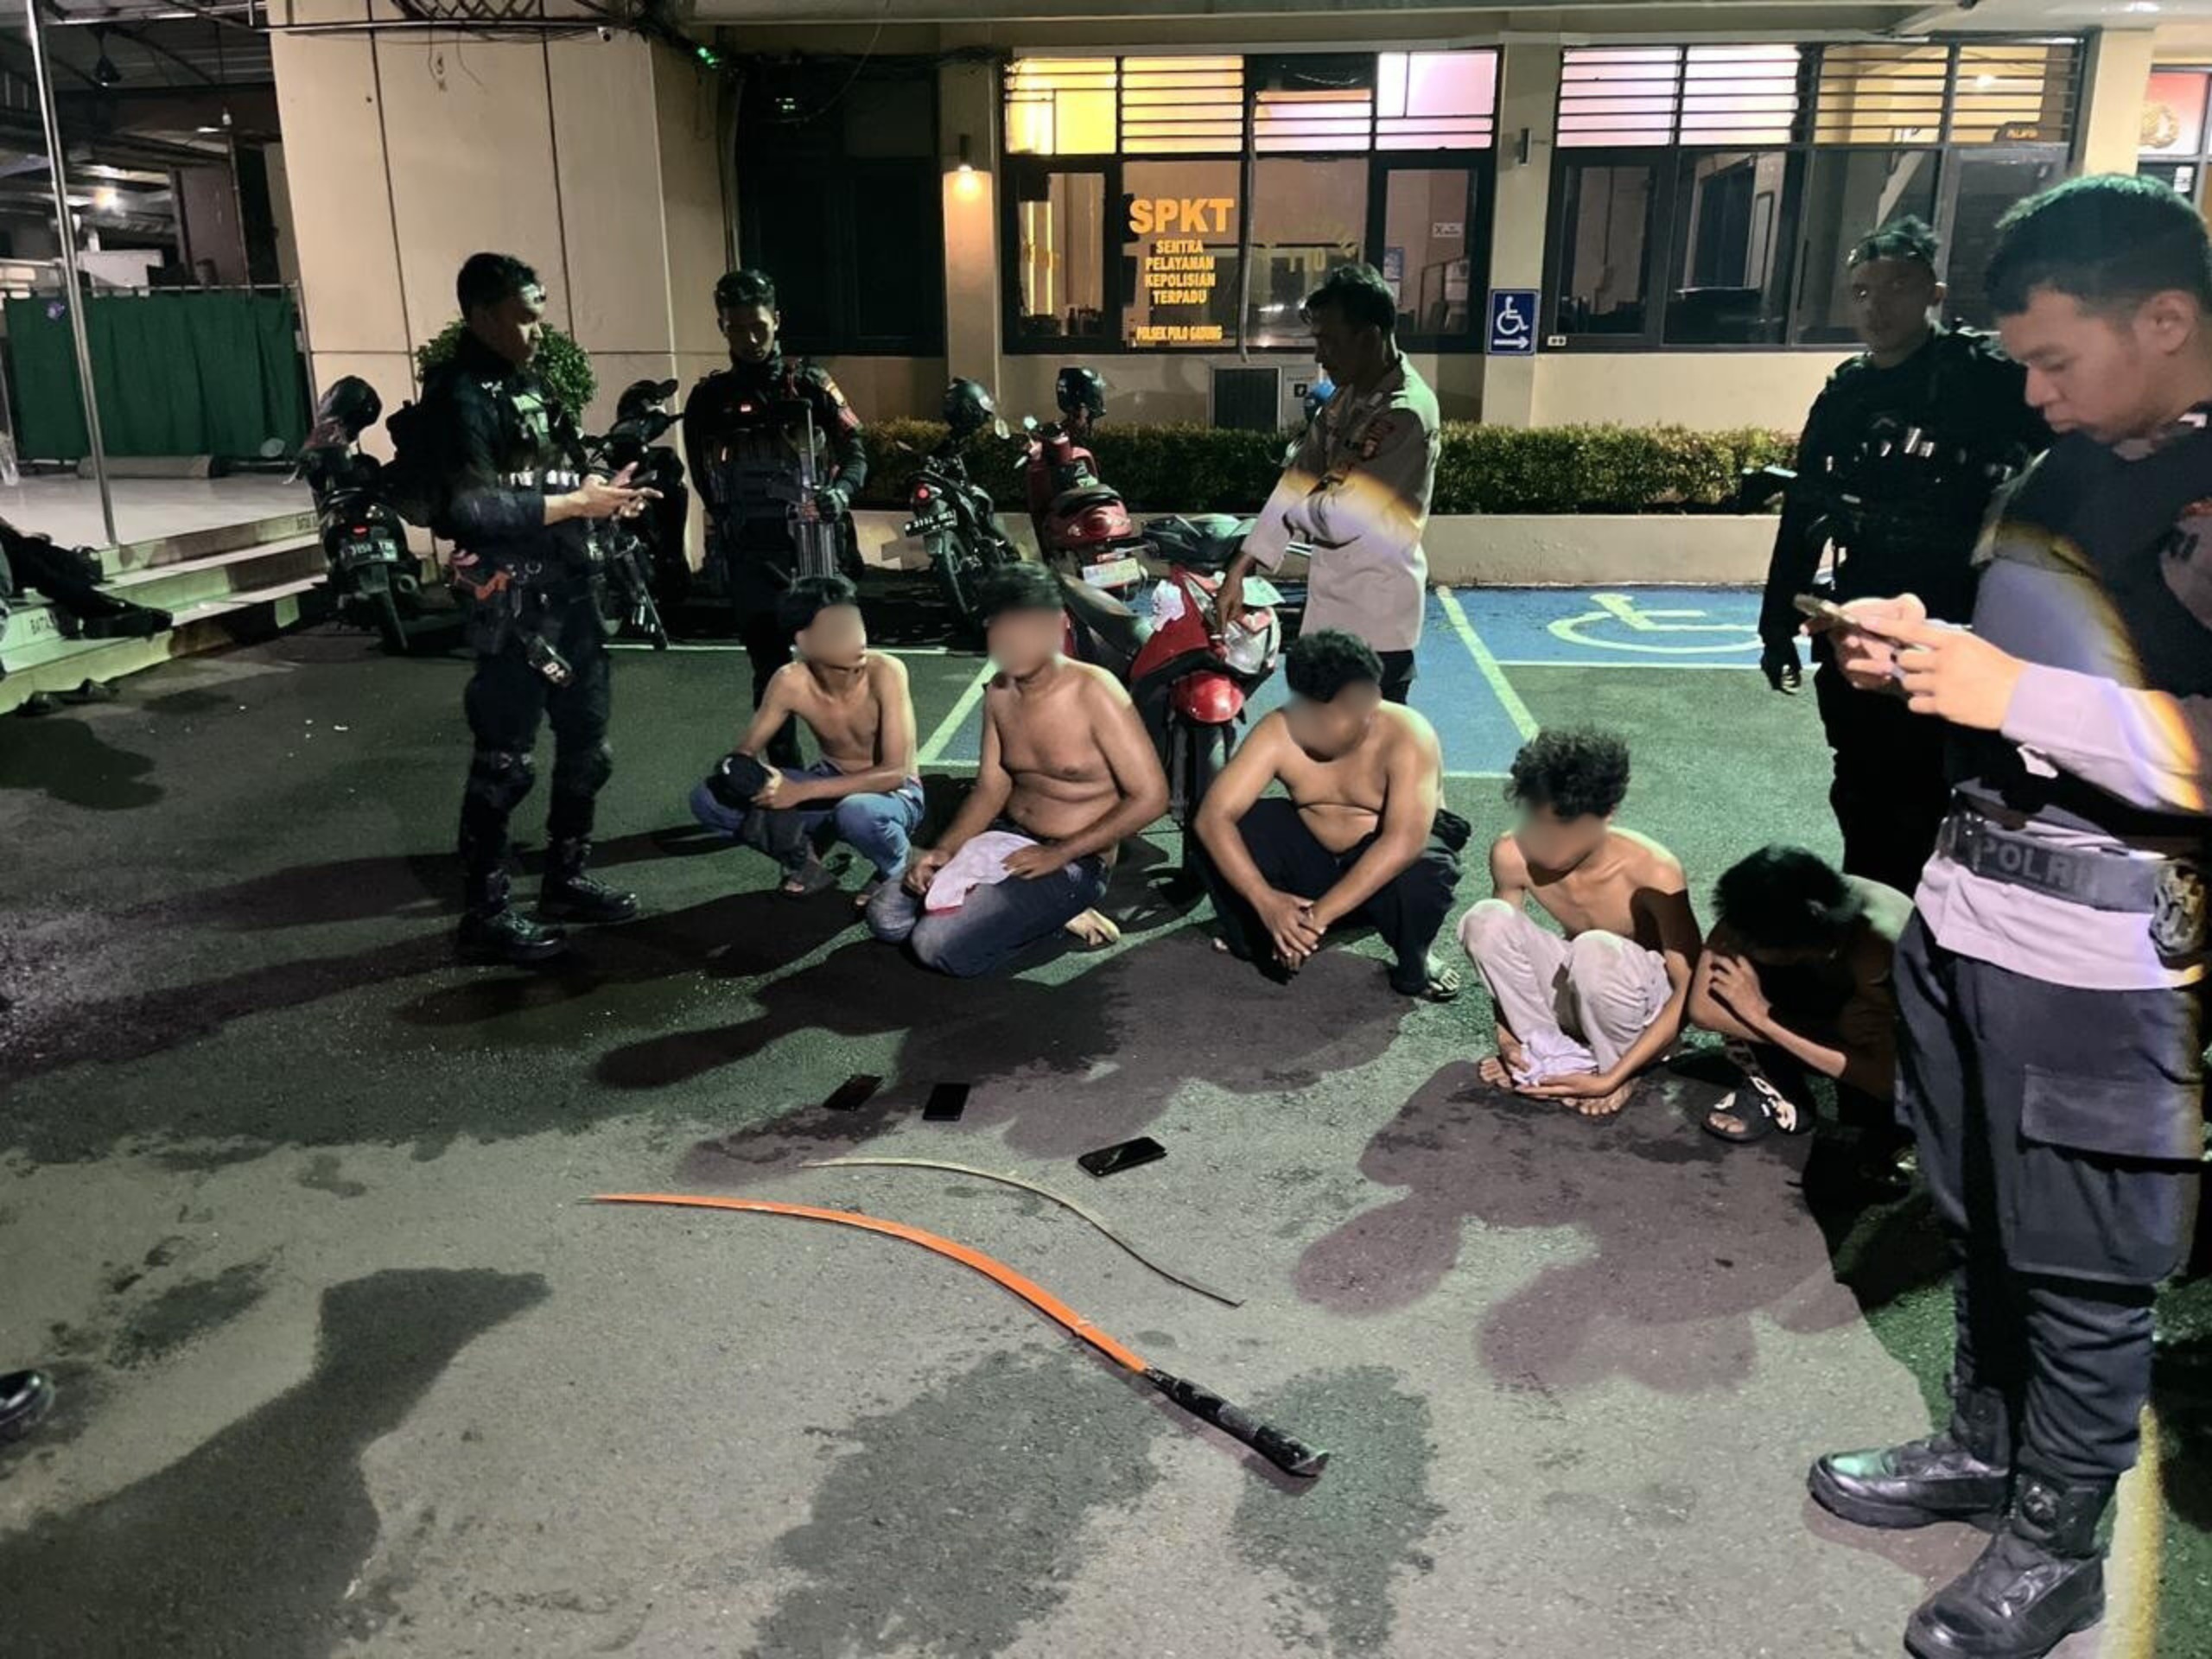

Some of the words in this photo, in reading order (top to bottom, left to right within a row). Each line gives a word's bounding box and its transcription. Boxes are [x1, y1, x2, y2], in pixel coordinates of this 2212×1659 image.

[1128, 198, 1235, 234] SPKT
[1156, 239, 1204, 254] SENTRA
[1145, 257, 1215, 271] PELAYANAN
[1145, 273, 1216, 288] KEPOLISIAN
[1153, 289, 1207, 304] TERPADU
